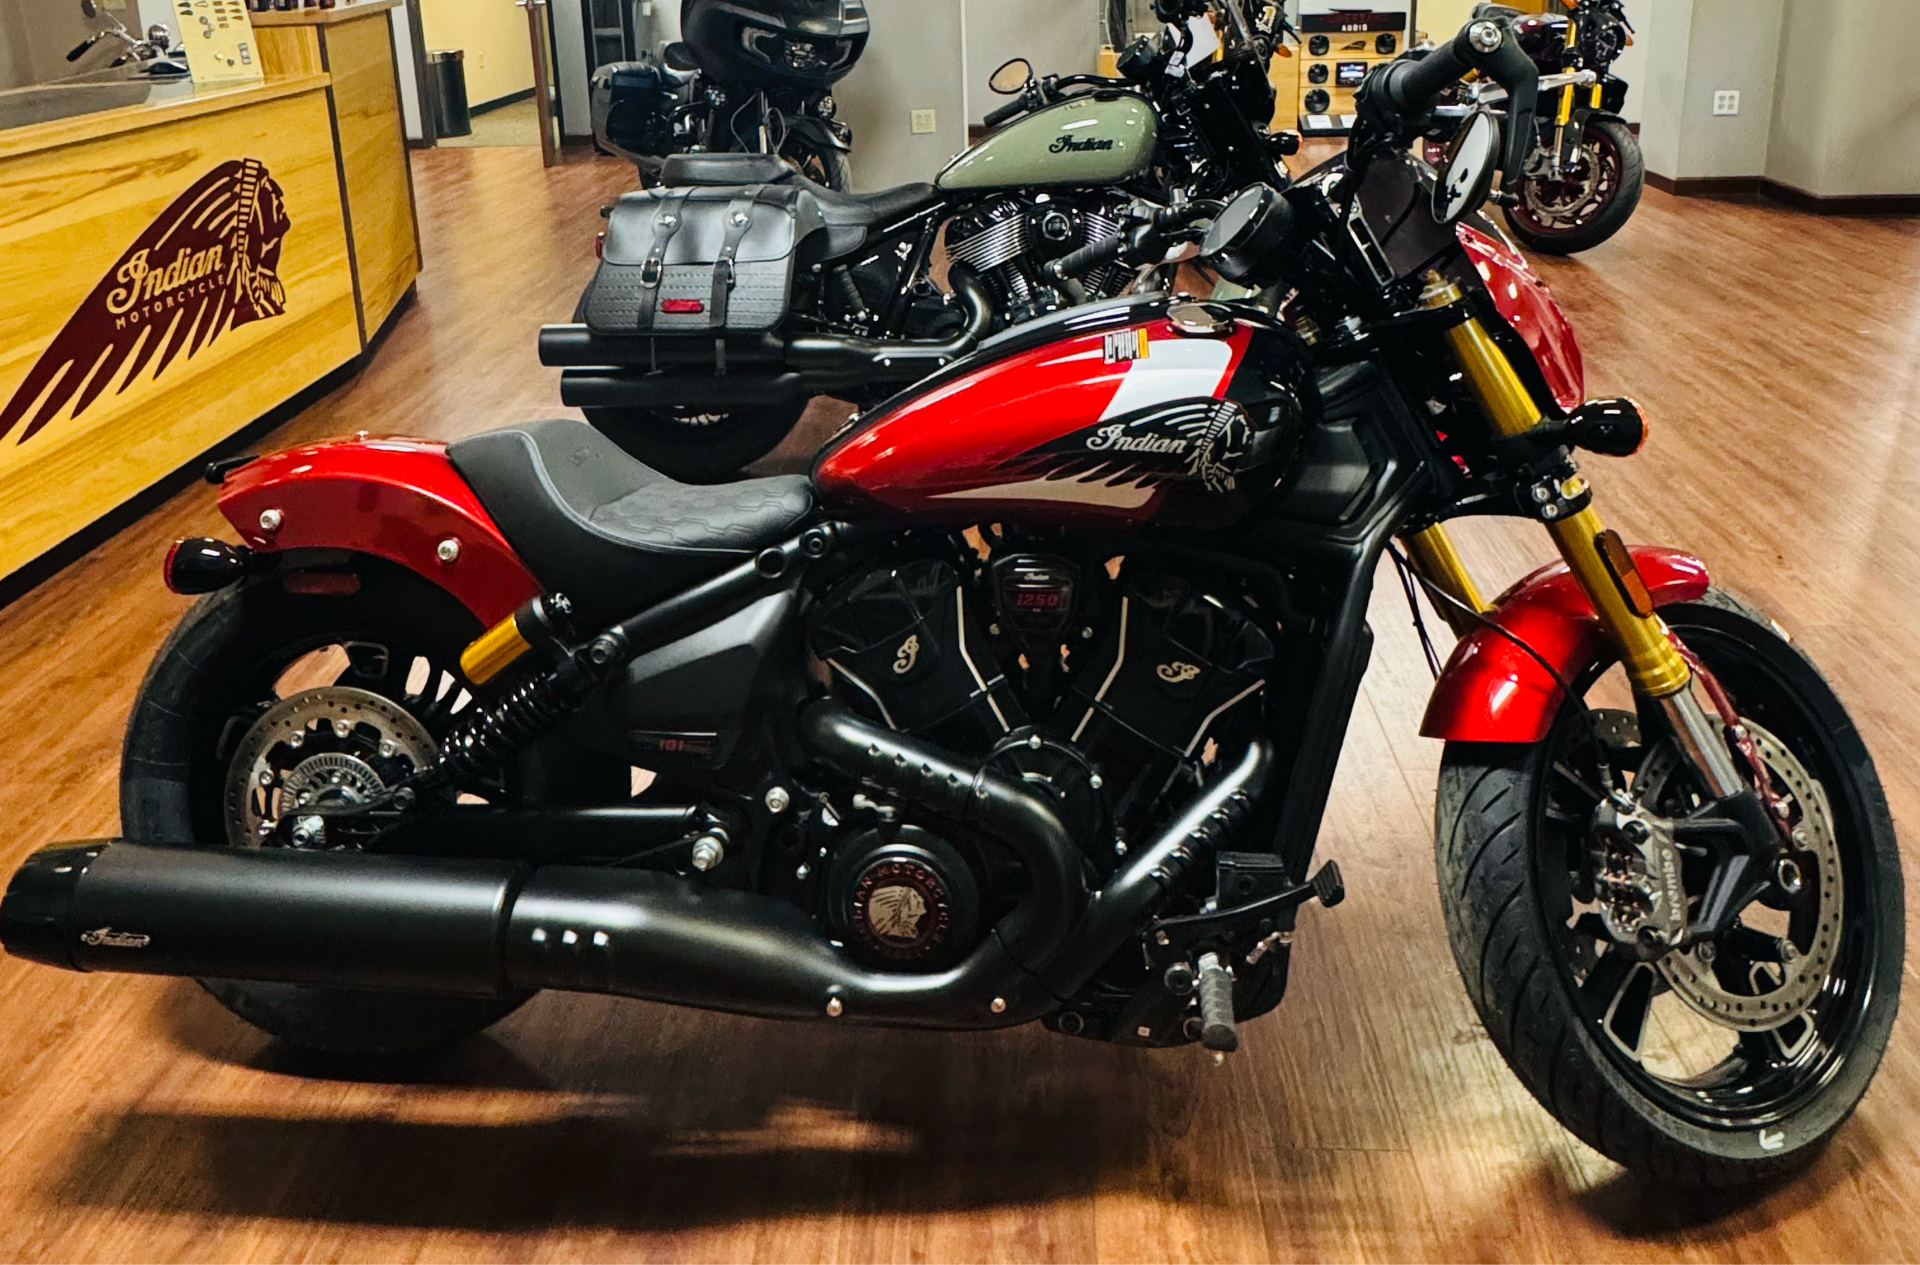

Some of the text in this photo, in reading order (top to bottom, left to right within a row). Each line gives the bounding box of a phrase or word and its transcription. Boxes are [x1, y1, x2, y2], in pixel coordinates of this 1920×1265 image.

[1341, 23, 1368, 32] AUDIO
[1049, 134, 1114, 153] Indian
[106, 244, 223, 314] Indian
[115, 274, 225, 330] MOTORCYCLE
[1086, 424, 1188, 454] Indian
[1016, 593, 1060, 607] 1250
[1662, 848, 1682, 921] brembo
